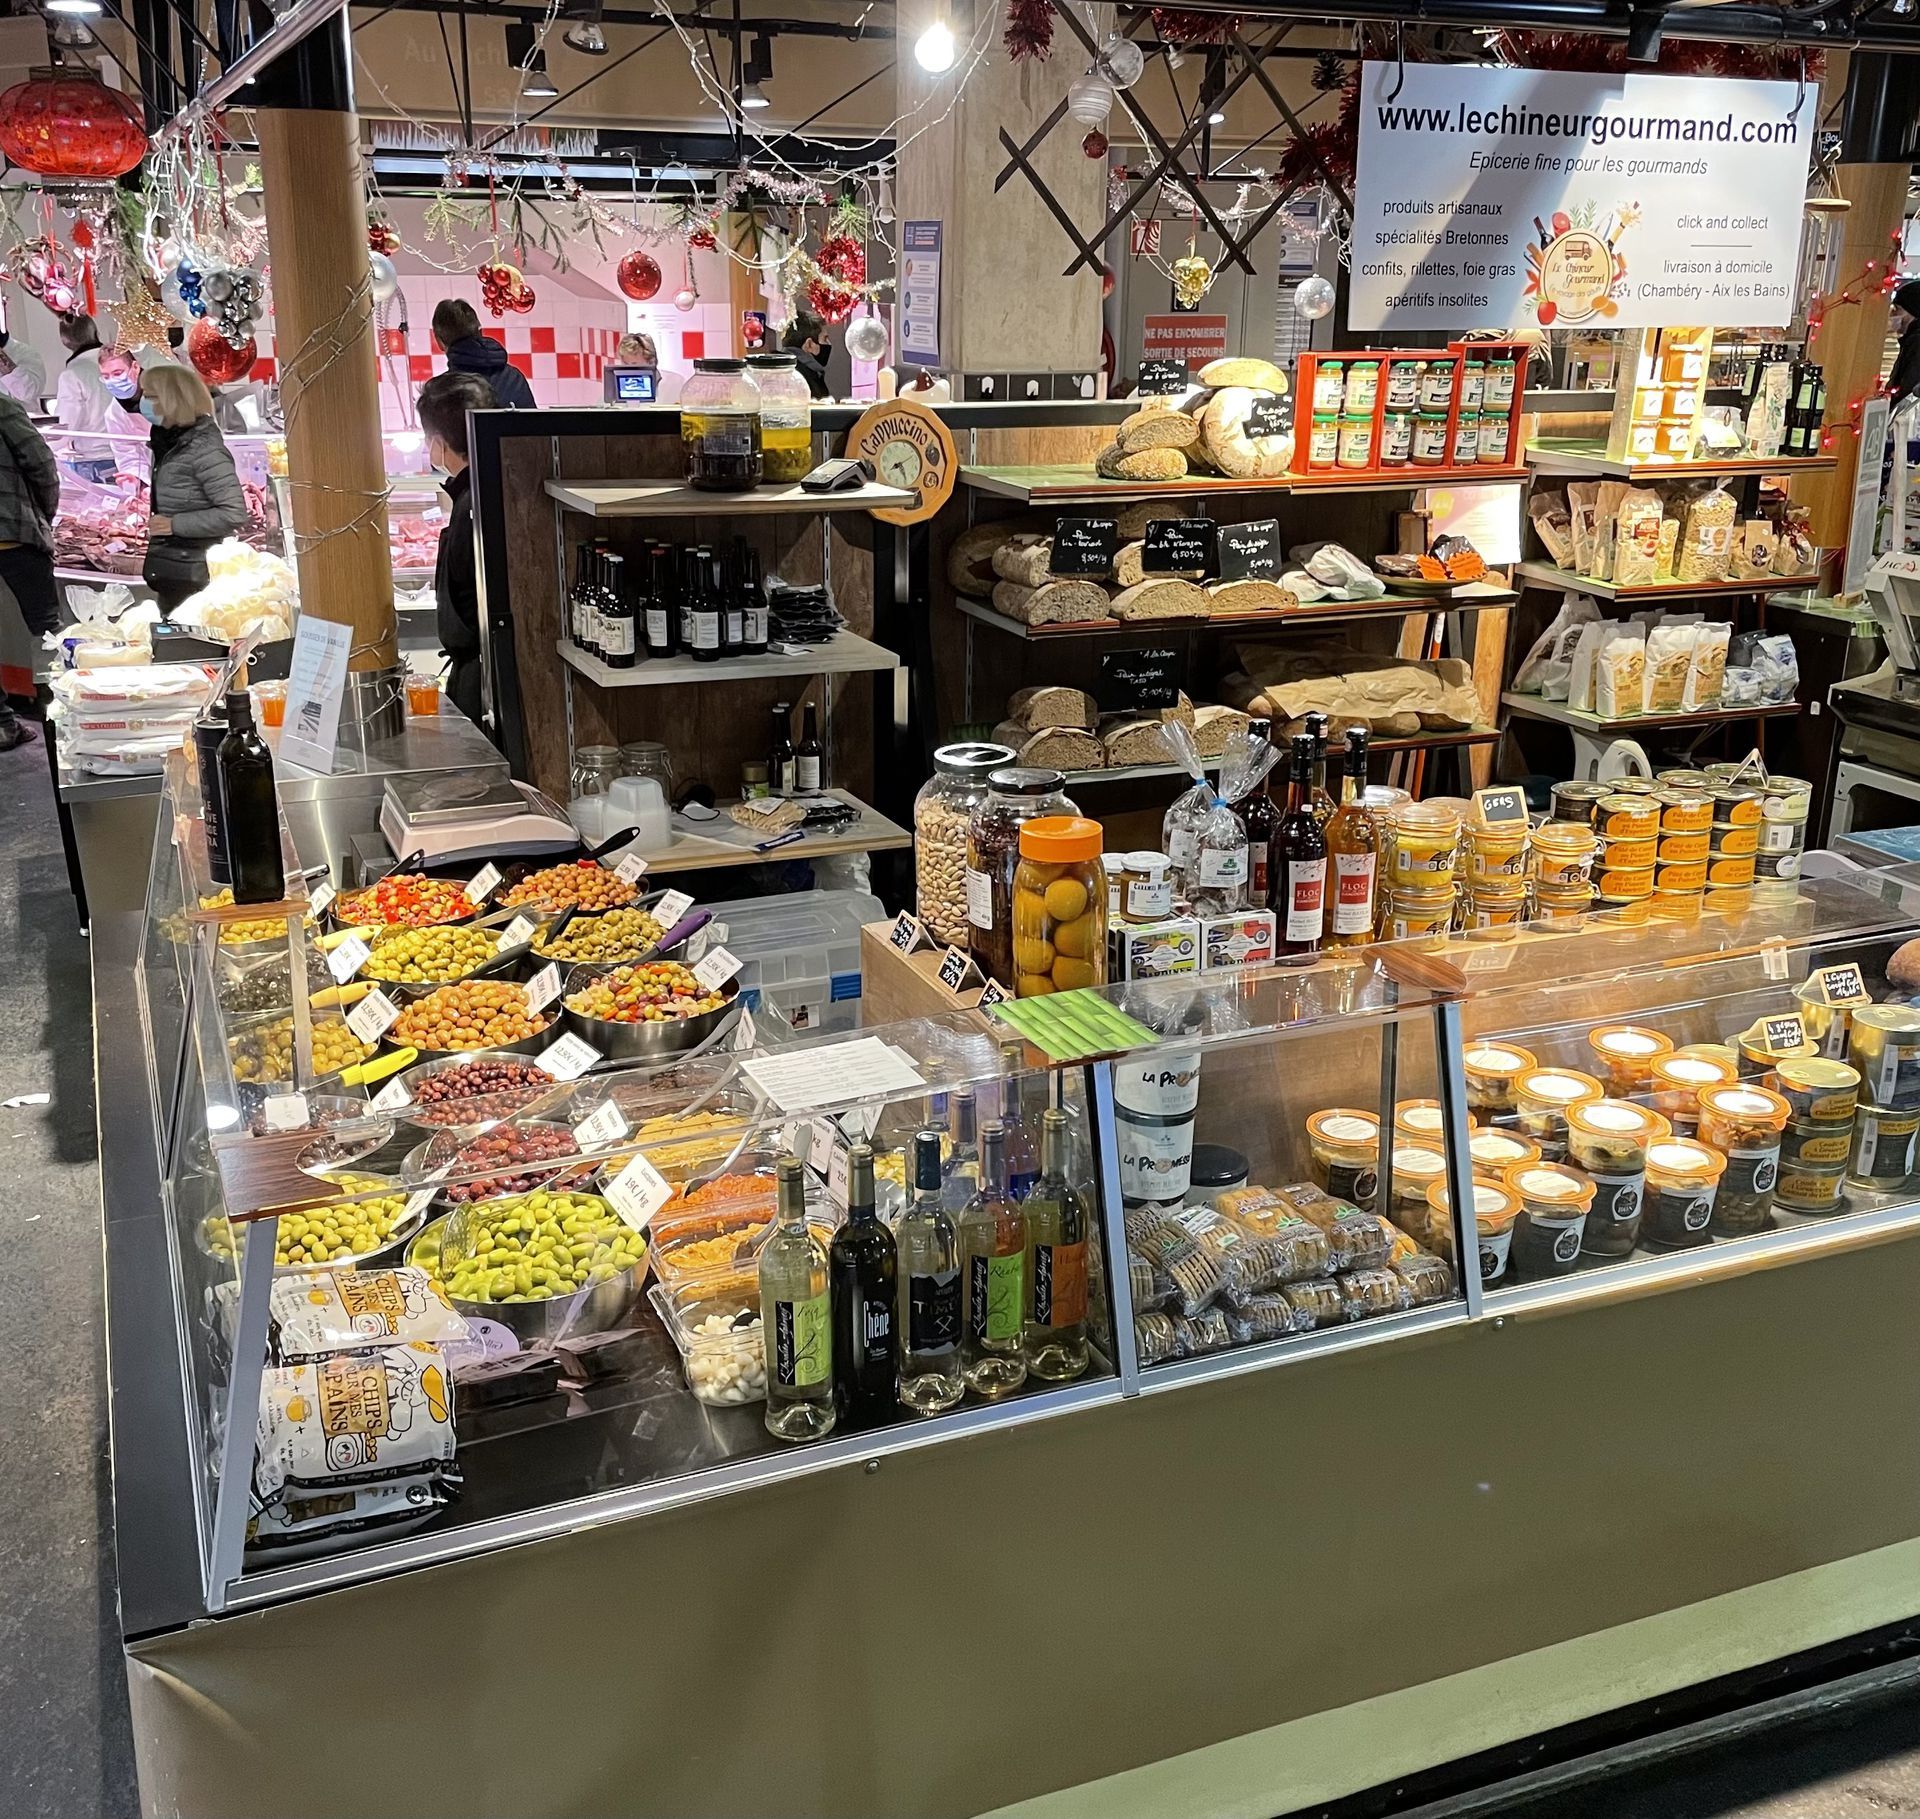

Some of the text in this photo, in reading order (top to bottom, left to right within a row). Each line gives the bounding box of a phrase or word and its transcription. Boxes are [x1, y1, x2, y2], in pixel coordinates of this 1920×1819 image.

[1377, 102, 1797, 145] www.lechineurgourmand.com
[1470, 151, 1708, 177] Epicerie fine pour les gourmands
[1383, 199, 1503, 217] produits artisanaux
[1677, 214, 1769, 230] click and collect
[1375, 229, 1509, 248] spécialités Bretonnes
[1362, 261, 1516, 280] confits, rillettes, foie gras
[1663, 260, 1773, 275] livraison à domicile
[1385, 290, 1489, 310] apéritifs insolites
[1637, 283, 1701, 302] (Chambéry
[1713, 284, 1730, 299] Aix
[1733, 284, 1750, 299] les
[1753, 284, 1790, 302] Bains)
[1144, 327, 1225, 340] NE PAS ENCOMBRER
[1143, 346, 1225, 360] SORTIE DE SECOURS
[860, 417, 928, 456] Cappuccino
[1880, 560, 1903, 570] JAC
[1296, 888, 1320, 898] FLOC
[1342, 882, 1367, 891] FLOC
[1142, 1071, 1156, 1083] LA
[1123, 1154, 1135, 1166] LA
[338, 1271, 369, 1313] OPAINS
[365, 1286, 378, 1304] MES
[375, 1277, 400, 1317] CHIPS
[863, 1300, 889, 1348] Chêne
[323, 1364, 349, 1432] OPAINS
[348, 1393, 362, 1418] MES
[361, 1375, 382, 1431] CHIPS
